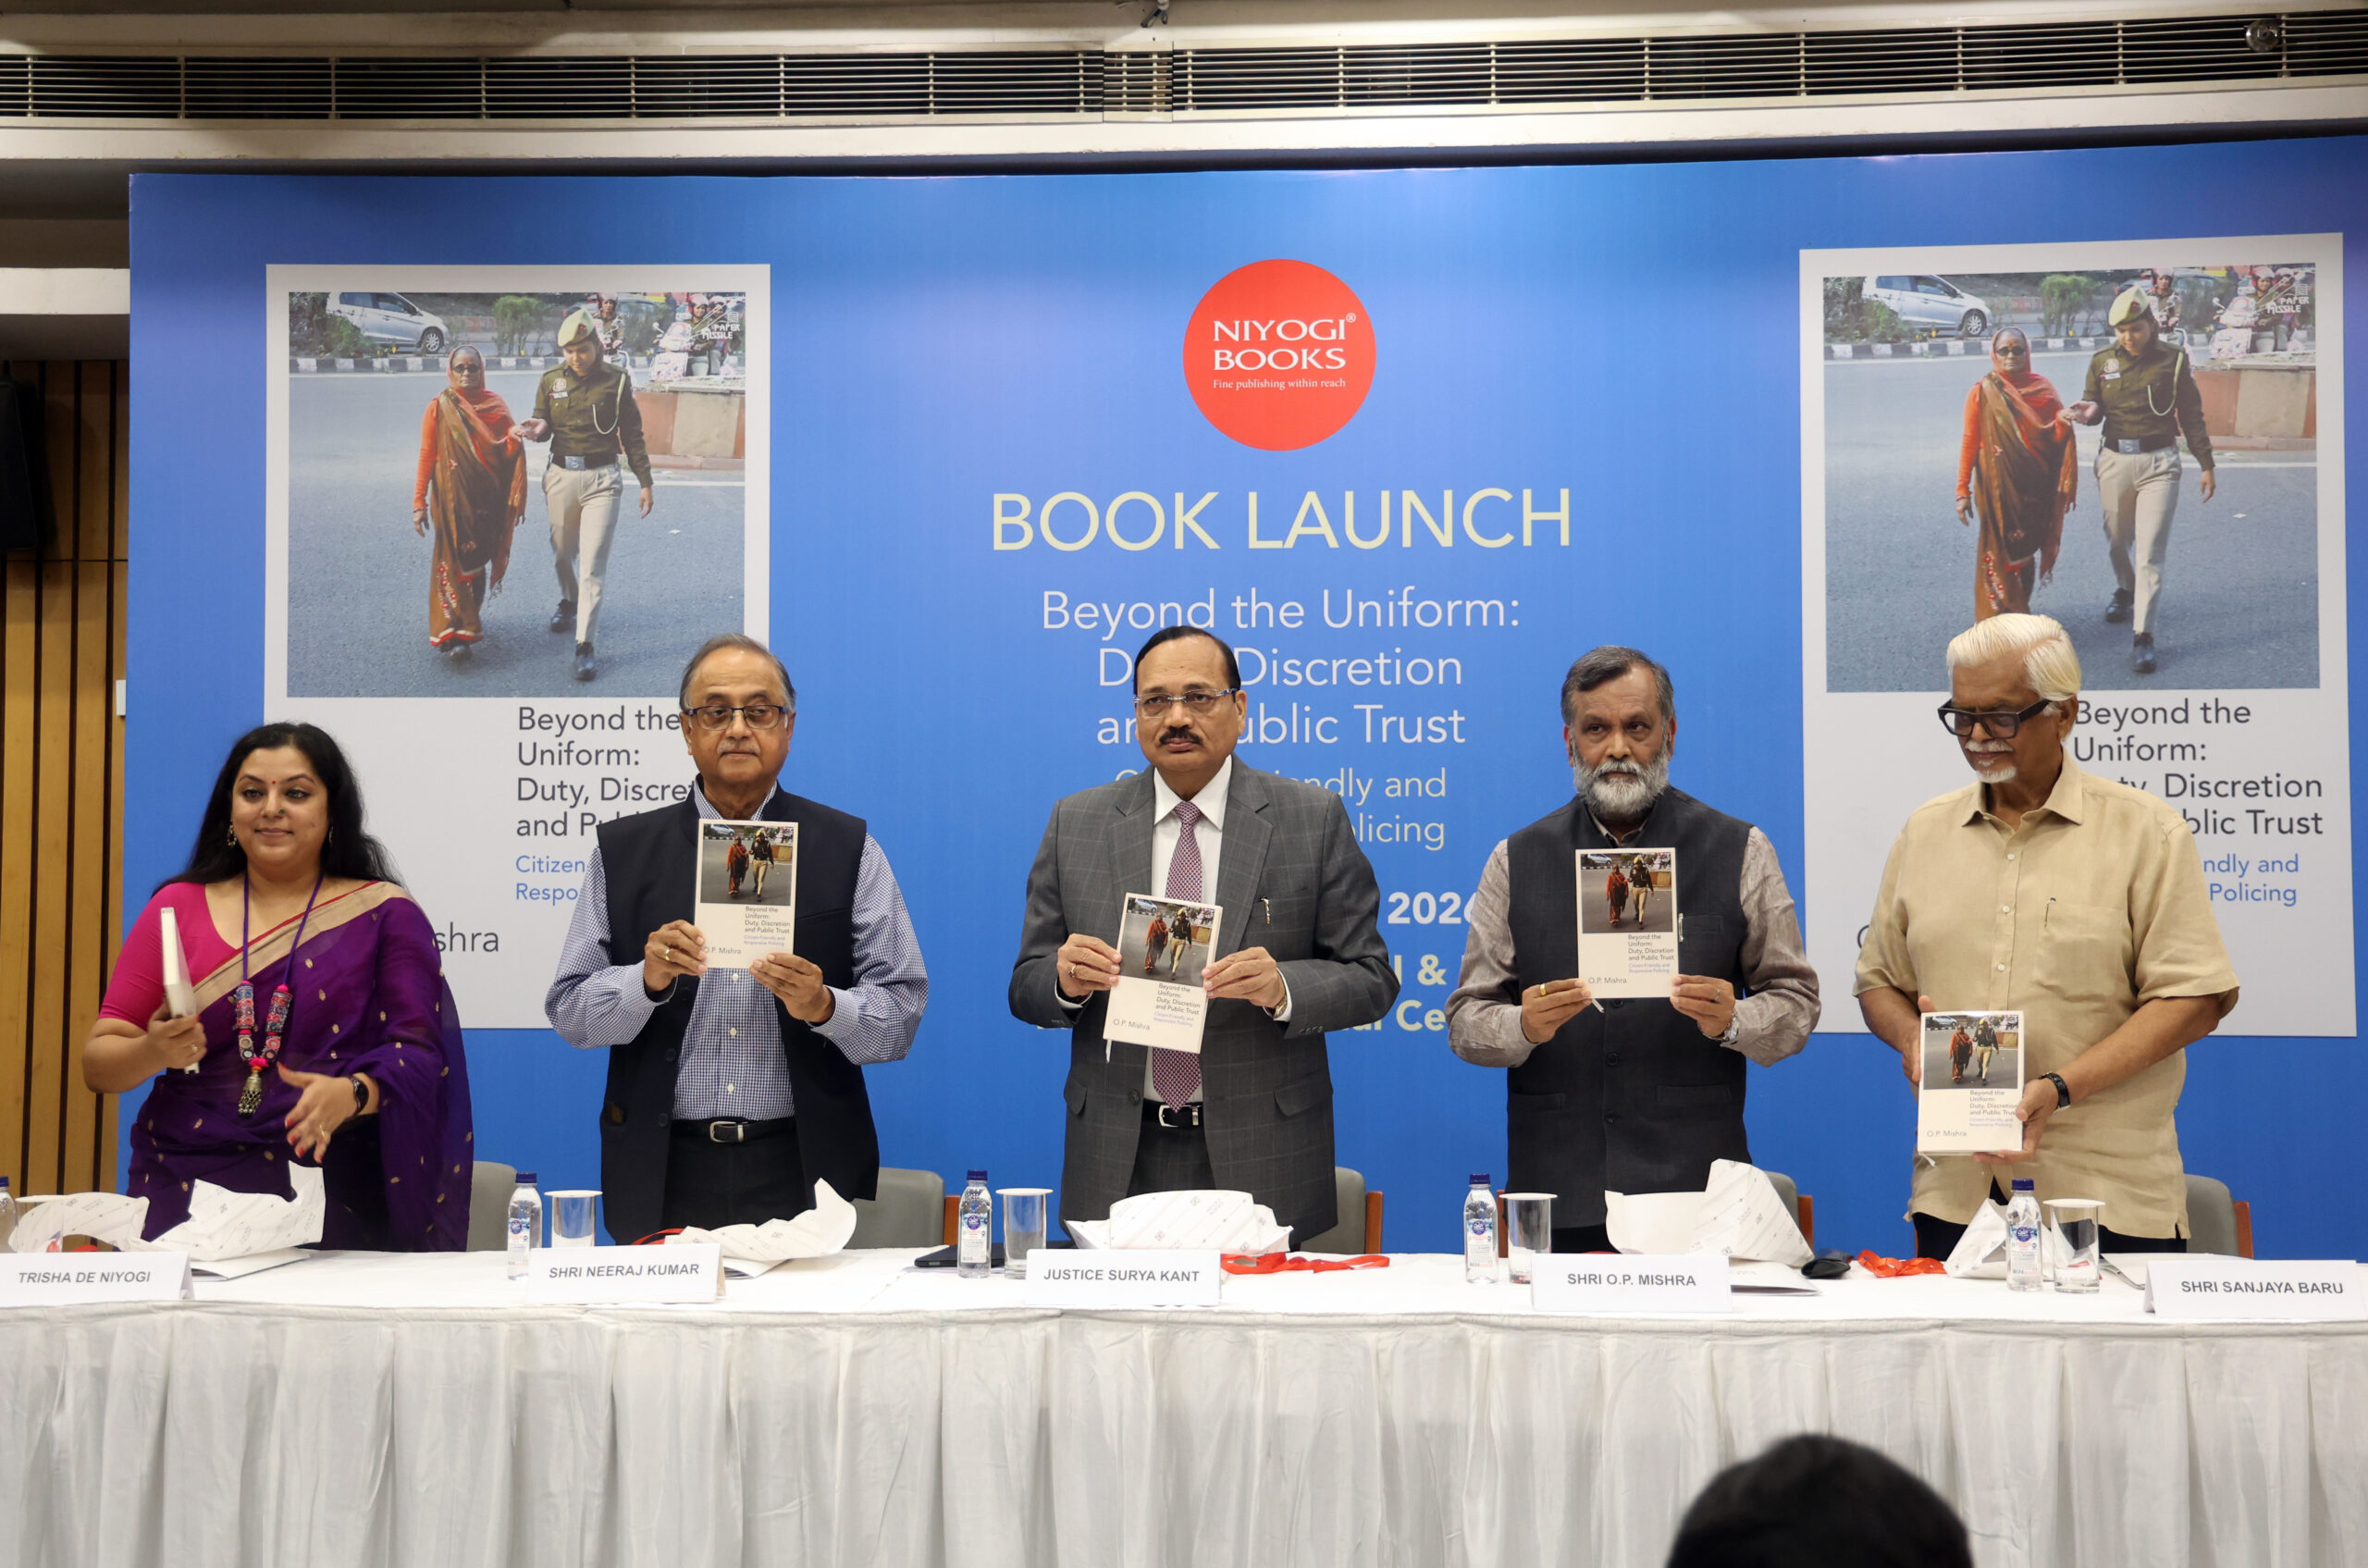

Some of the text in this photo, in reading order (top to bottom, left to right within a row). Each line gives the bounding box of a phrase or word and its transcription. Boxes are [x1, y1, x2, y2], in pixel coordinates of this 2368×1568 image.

[1214, 348, 1347, 371] BOOKS
[1213, 377, 1346, 390] Fine publishing within reach
[993, 488, 1570, 552] BOOK LAUNCH
[1043, 585, 1519, 640] Beyond the Uniform:
[1234, 647, 1462, 686] Discretion
[519, 705, 681, 738] Beyond the
[1237, 702, 1338, 745] ublic
[1353, 704, 1466, 744] Trust
[2074, 697, 2251, 733] Beyond the
[518, 740, 639, 766] Uniform:
[2074, 735, 2206, 762] Uniform:
[517, 777, 589, 809] Duty,
[1385, 767, 1446, 798] and
[2164, 772, 2322, 798] Discretion
[516, 810, 568, 837] and
[2182, 808, 2324, 835] blic Trust
[2257, 853, 2299, 873] and
[516, 883, 579, 907] Respo
[2210, 882, 2297, 907] Policing
[435, 921, 499, 953] shra
[1417, 954, 1447, 986] &
[1157, 990, 1181, 998] Uniform:
[1158, 982, 1180, 991] Beyond
[1167, 1005, 1184, 1013] Public
[1172, 998, 1201, 1008] Discretion
[1128, 1020, 1151, 1031] Mishra
[18, 1271, 151, 1284] TRISHA DE NIYOGI
[549, 1264, 699, 1278] SHRI NEERAJ KUMAR
[1043, 1268, 1201, 1282] JUSTICE SURYA KANT
[1567, 1273, 1696, 1287] SHRI O.P. MISHRA
[2181, 1280, 2344, 1294] SHRI SANJAYA BARU
